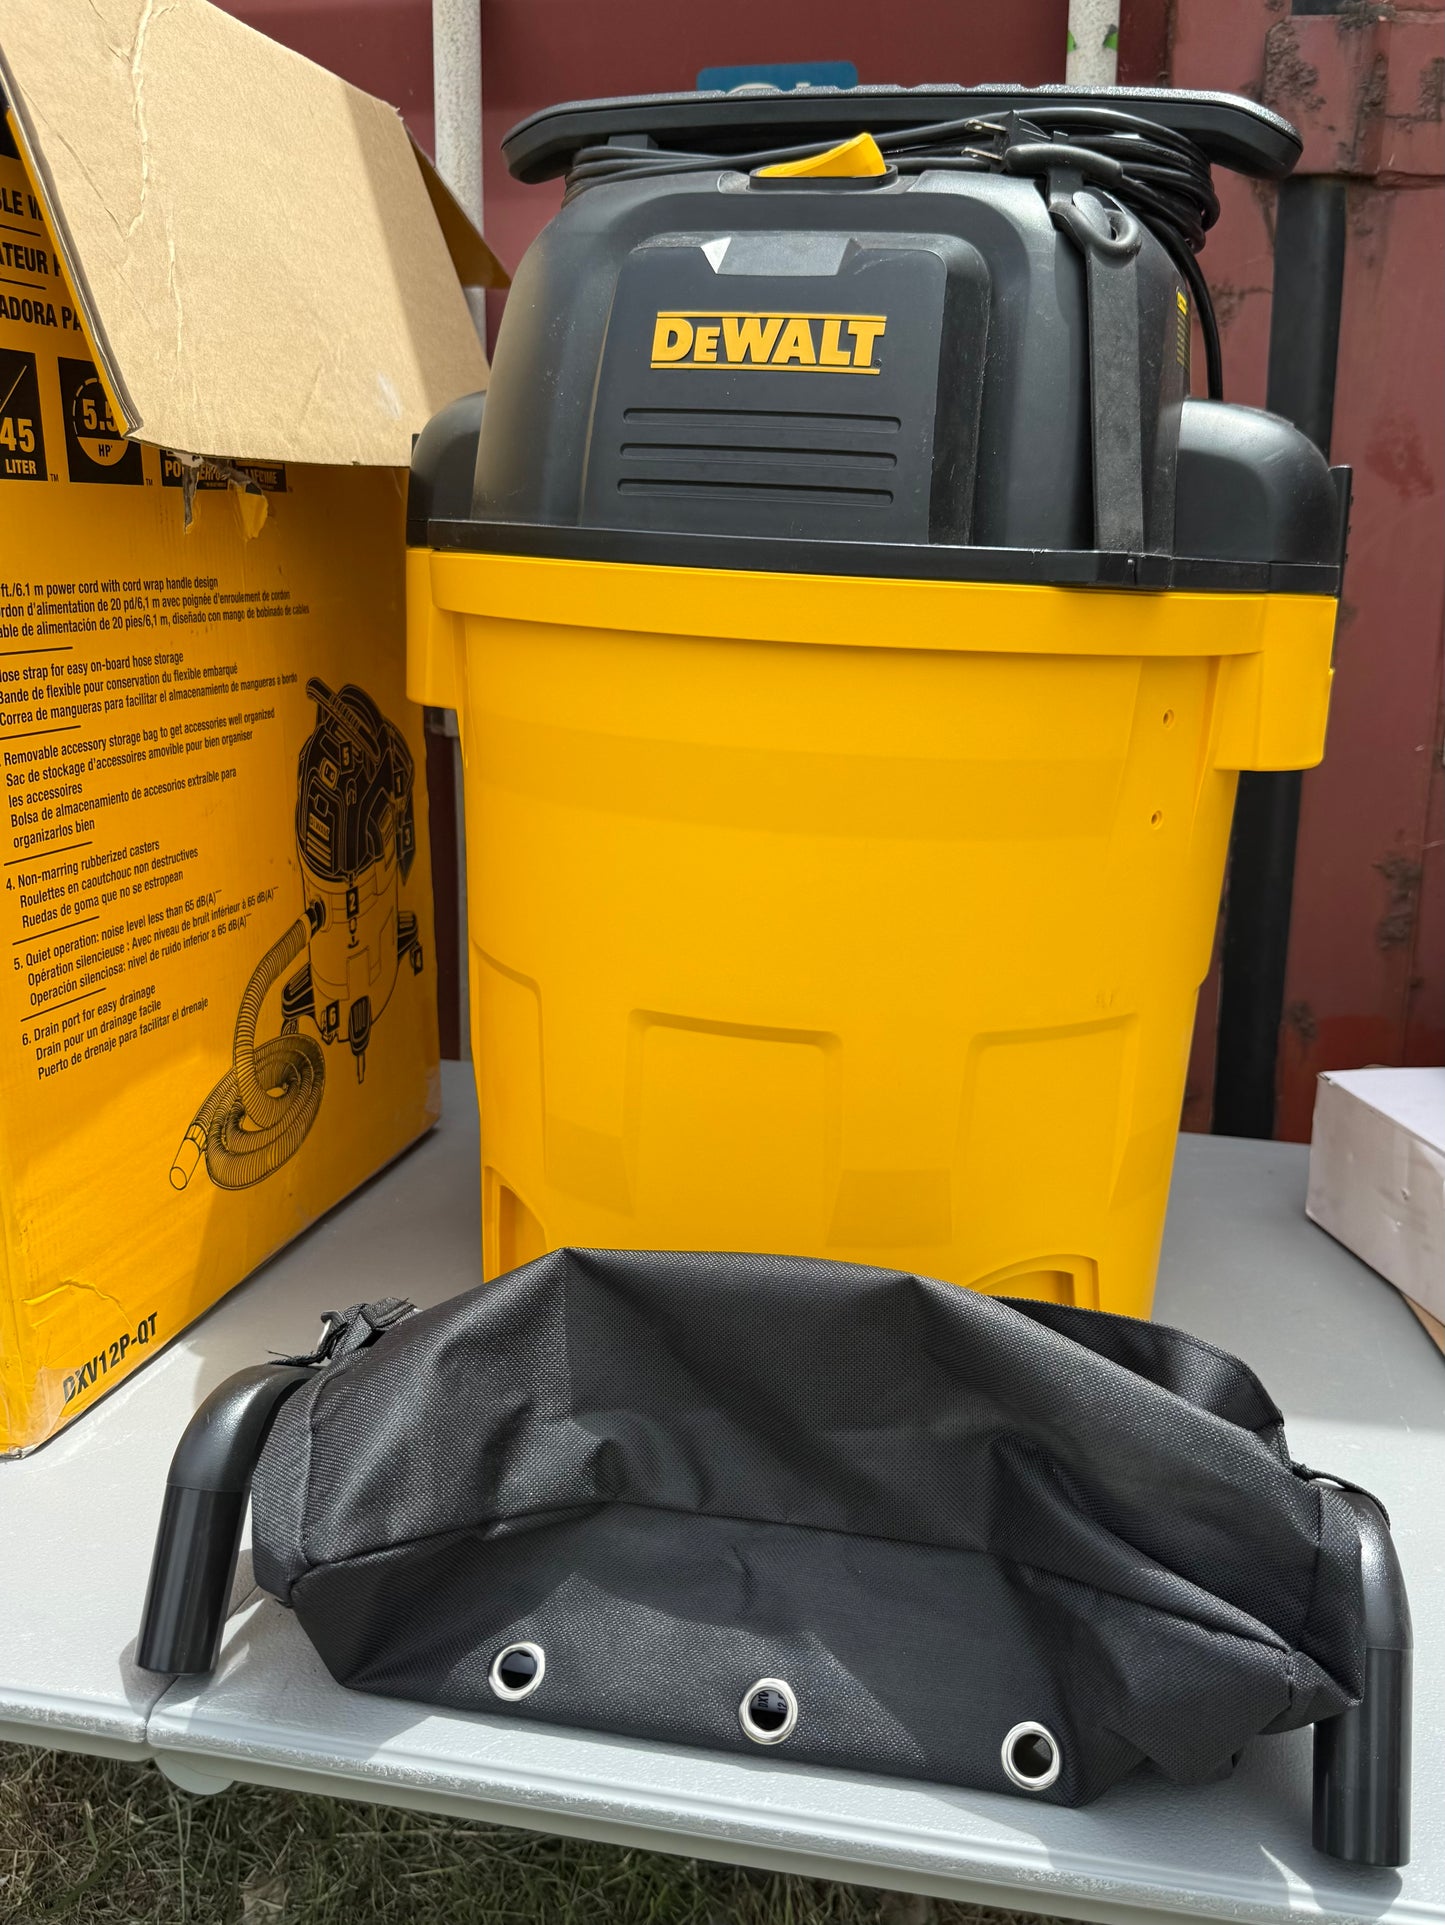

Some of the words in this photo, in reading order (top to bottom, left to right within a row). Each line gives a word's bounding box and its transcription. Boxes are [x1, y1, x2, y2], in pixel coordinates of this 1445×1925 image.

[0, 416, 35, 453] 45
[5, 458, 37, 475] LITER
[50, 473, 59, 482] TM
[27, 600, 95, 616] d'alimentation
[98, 598, 108, 612] de
[110, 597, 121, 611] 20
[124, 596, 149, 612] pd/6,1
[162, 598, 180, 609] avec
[46, 583, 76, 598] power
[78, 580, 98, 594] cord
[101, 579, 120, 593] with
[123, 578, 141, 592] cord
[144, 579, 164, 592] wrap
[166, 576, 192, 590] handle
[194, 576, 218, 590] design
[22, 623, 33, 637] de
[37, 618, 97, 636] alimentación
[100, 617, 110, 631] de
[112, 616, 122, 629] 20
[125, 614, 158, 631] pies/6,1
[172, 610, 206, 625] diseñado
[208, 611, 221, 622] con
[223, 609, 245, 623] mango
[246, 607, 256, 619] de
[256, 606, 284, 618] bobinado
[292, 603, 310, 615] cables
[23, 665, 48, 681] strap
[51, 663, 64, 677] for
[67, 662, 88, 676] easy
[90, 655, 131, 673] on-board
[132, 655, 152, 668] hose
[154, 652, 184, 666] storage
[32, 687, 44, 701] de
[46, 682, 81, 699] flexible
[83, 680, 104, 696] pour
[106, 672, 160, 691] conservation
[162, 669, 172, 683] du
[174, 667, 201, 681] flexible
[203, 662, 238, 679] embarqué
[0, 711, 33, 727] Correa
[35, 707, 48, 721] de
[50, 701, 102, 719] mangueras
[104, 698, 124, 713] para
[125, 692, 158, 708] facilitar
[159, 692, 167, 703] el
[168, 682, 229, 702] almacenamiento
[230, 680, 239, 692] de
[240, 677, 276, 692] mangueras
[281, 672, 298, 685] bordo
[4, 745, 59, 766] Removable
[61, 738, 107, 756] accessory
[109, 731, 141, 747] storage
[142, 729, 159, 742] bag
[160, 726, 169, 738] to
[169, 723, 183, 739] get
[184, 716, 228, 734] accessories
[228, 712, 243, 726] well
[243, 707, 275, 724] organized
[5, 772, 25, 787] Sac
[27, 769, 40, 783] de
[42, 762, 86, 780] stockage
[88, 750, 147, 771] d'accessoires
[148, 742, 184, 760] amovible
[185, 740, 203, 755] pour
[204, 736, 220, 748] bien
[221, 730, 253, 746] organiser
[342, 746, 350, 767] 5
[8, 794, 24, 808] les
[26, 783, 83, 804] accessoires
[10, 811, 39, 828] Bolsa
[41, 807, 53, 821] de
[55, 791, 130, 817] almacenamiento
[131, 788, 142, 800] de
[143, 778, 186, 798] accesorios
[221, 767, 237, 782] para
[13, 824, 73, 849] organizarlos
[75, 818, 95, 833] bien
[5, 877, 16, 891] 4.
[17, 862, 79, 888] Non-marring
[81, 847, 128, 871] rubberized
[129, 840, 160, 857] casters
[20, 886, 66, 909] Roulettes
[67, 882, 79, 895] en
[81, 866, 132, 890] caoutchouc
[133, 862, 150, 876] non
[151, 848, 199, 870] destructives
[22, 908, 58, 929] Ruedas
[60, 903, 72, 917] de
[74, 896, 100, 915] goma
[101, 890, 118, 906] que
[119, 886, 131, 899] no
[132, 883, 143, 895] se
[144, 870, 184, 891] estropean
[13, 957, 24, 971] 5.
[26, 946, 52, 967] Quiet
[53, 933, 100, 958] operation:
[101, 924, 125, 941] noise
[126, 915, 146, 932] level
[148, 911, 165, 926] less
[166, 905, 184, 919] than
[185, 899, 195, 912] 65
[28, 961, 74, 987] Opération
[76, 943, 125, 969] silencieuse
[132, 934, 152, 950] Avec
[154, 924, 180, 942] niveau
[181, 919, 191, 932] de
[192, 912, 210, 928] bruit
[211, 902, 240, 920] inférieur
[247, 894, 256, 907] 65
[30, 979, 78, 1006] Operación
[80, 963, 126, 988] silenciosa:
[127, 952, 148, 970] nivel
[149, 948, 160, 962] de
[161, 941, 182, 957] ruido
[183, 931, 210, 949] inferior
[218, 924, 227, 936] 65
[22, 1033, 32, 1047] 6.
[34, 1022, 60, 1042] Drain
[61, 1012, 81, 1033] port
[82, 1007, 95, 1022] for
[97, 999, 118, 1016] easy
[119, 984, 156, 1007] drainage
[36, 1041, 62, 1061] Drain
[63, 1031, 85, 1052] pour
[86, 1026, 99, 1040] un
[100, 1010, 138, 1034] drainage
[139, 999, 162, 1017] facile
[38, 1057, 69, 1080] Puerto
[71, 1052, 82, 1066] de
[84, 1037, 117, 1060] drenaje
[118, 1028, 138, 1048] para
[139, 1014, 170, 1036] facilitar
[172, 1008, 180, 1022] el
[181, 997, 209, 1018] drenaje
[63, 1311, 158, 1404] DXV12P-QT
